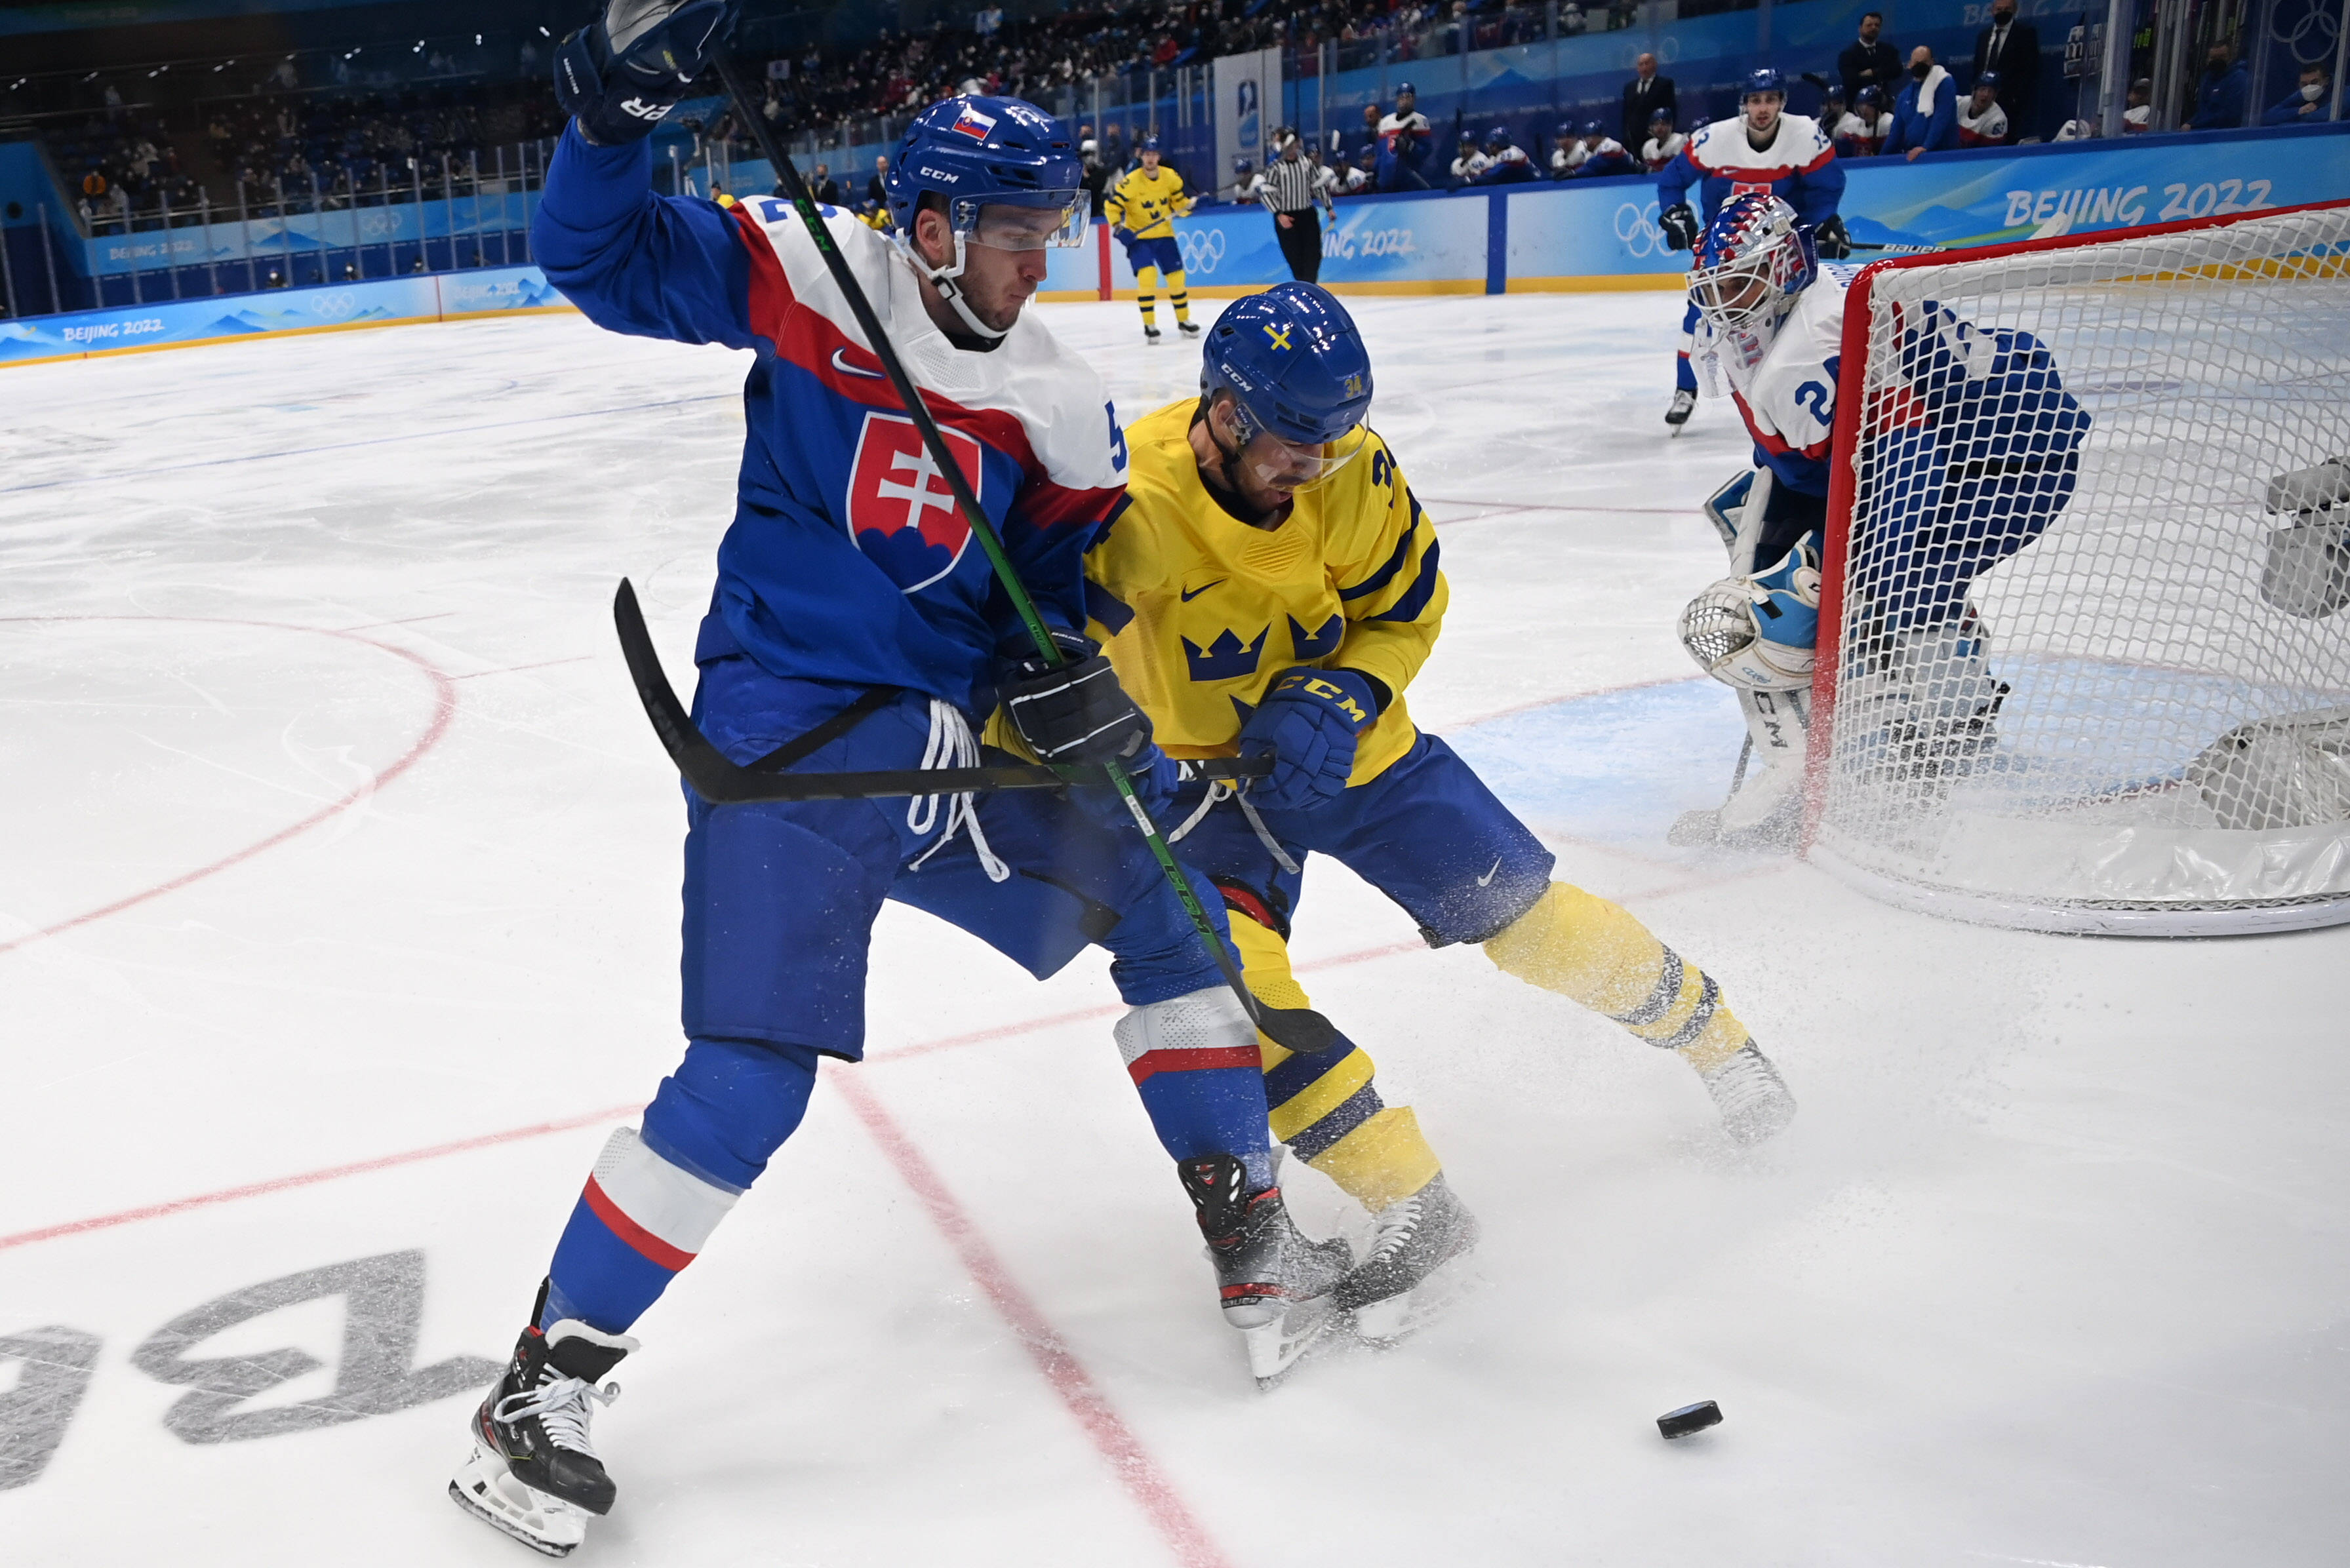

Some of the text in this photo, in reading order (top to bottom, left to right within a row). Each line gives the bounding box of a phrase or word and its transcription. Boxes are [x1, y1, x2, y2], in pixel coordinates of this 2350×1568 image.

[920, 166, 960, 184] CCM
[2004, 179, 2277, 236] BEIJING 2022
[796, 199, 831, 252] CCM
[1361, 228, 1417, 257] 2022
[1882, 243, 1947, 254] BAUER
[63, 319, 165, 343] BEIJING 2022
[1221, 363, 1253, 392] CCM
[1345, 375, 1363, 398] 34
[1275, 675, 1366, 723] CCM
[1753, 690, 1788, 748] CM
[1162, 865, 1211, 935] CCM
